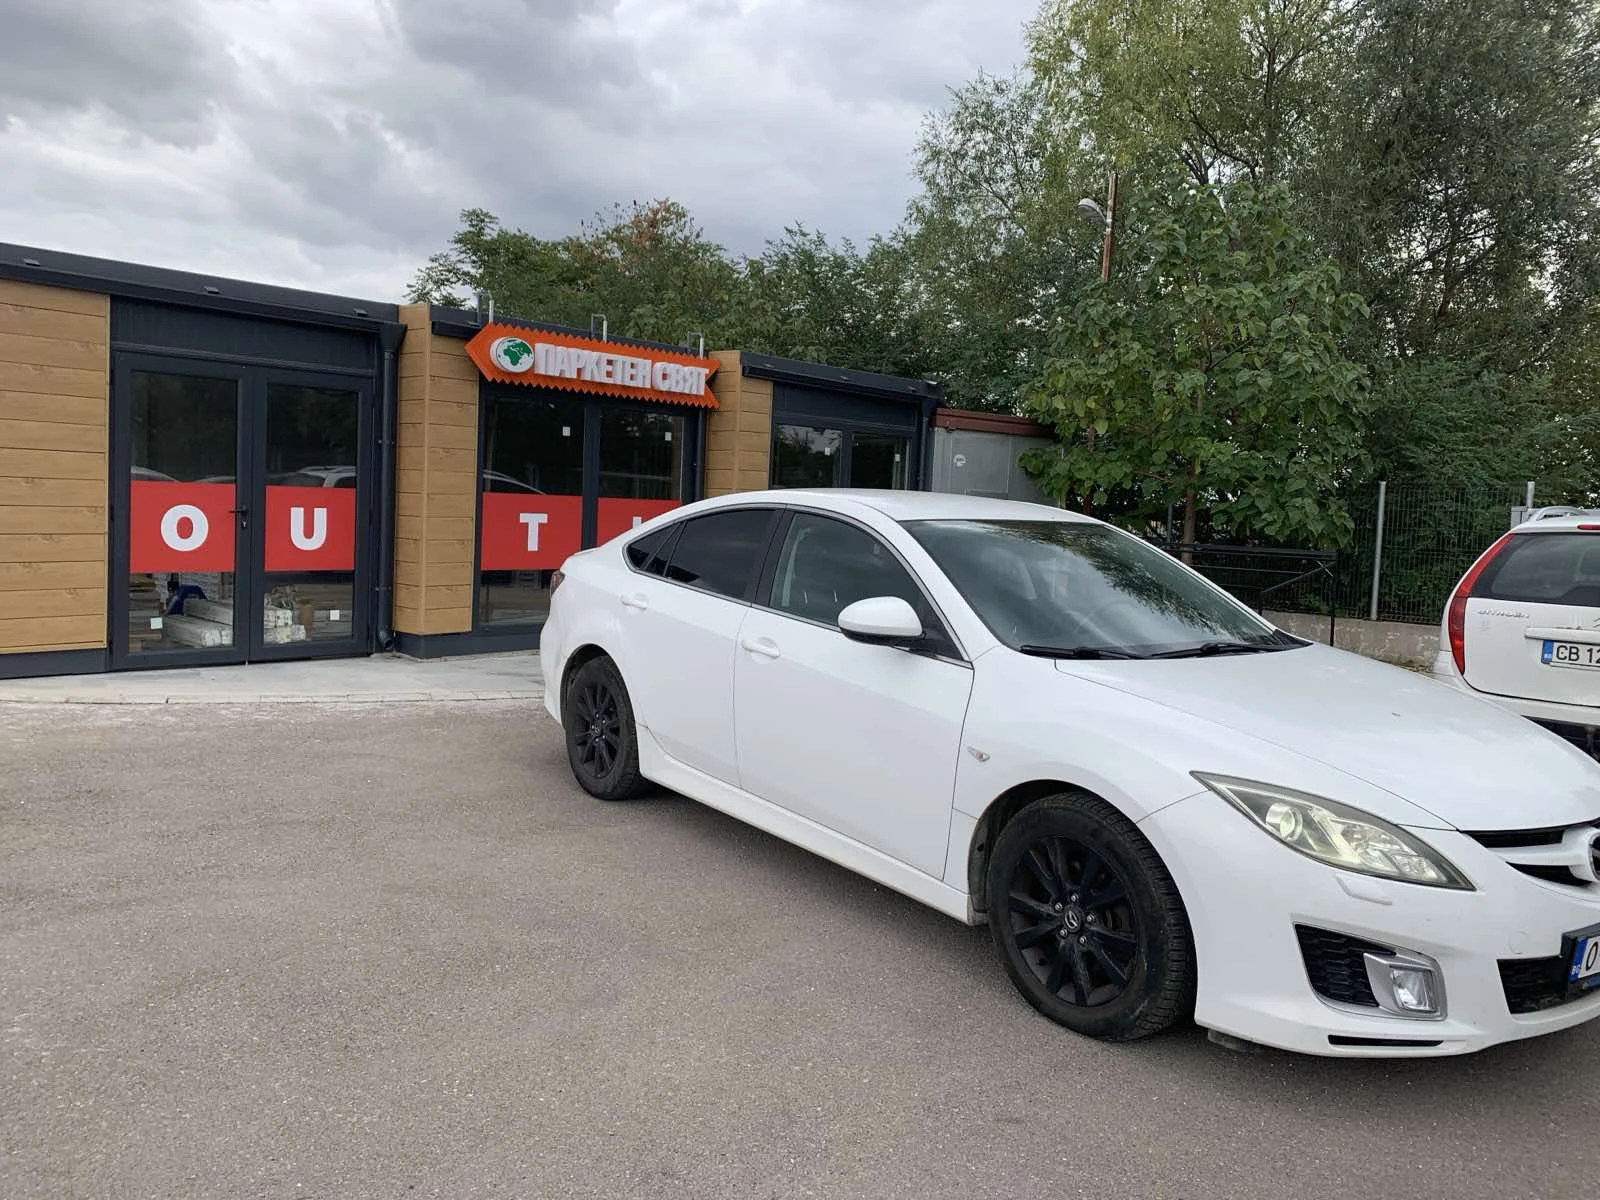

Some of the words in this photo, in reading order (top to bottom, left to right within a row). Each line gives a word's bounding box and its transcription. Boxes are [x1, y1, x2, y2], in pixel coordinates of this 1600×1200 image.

[534, 342, 652, 389] ПАРКЕТЕН
[653, 361, 710, 395] СВЯТ
[1555, 645, 1580, 662] CB
